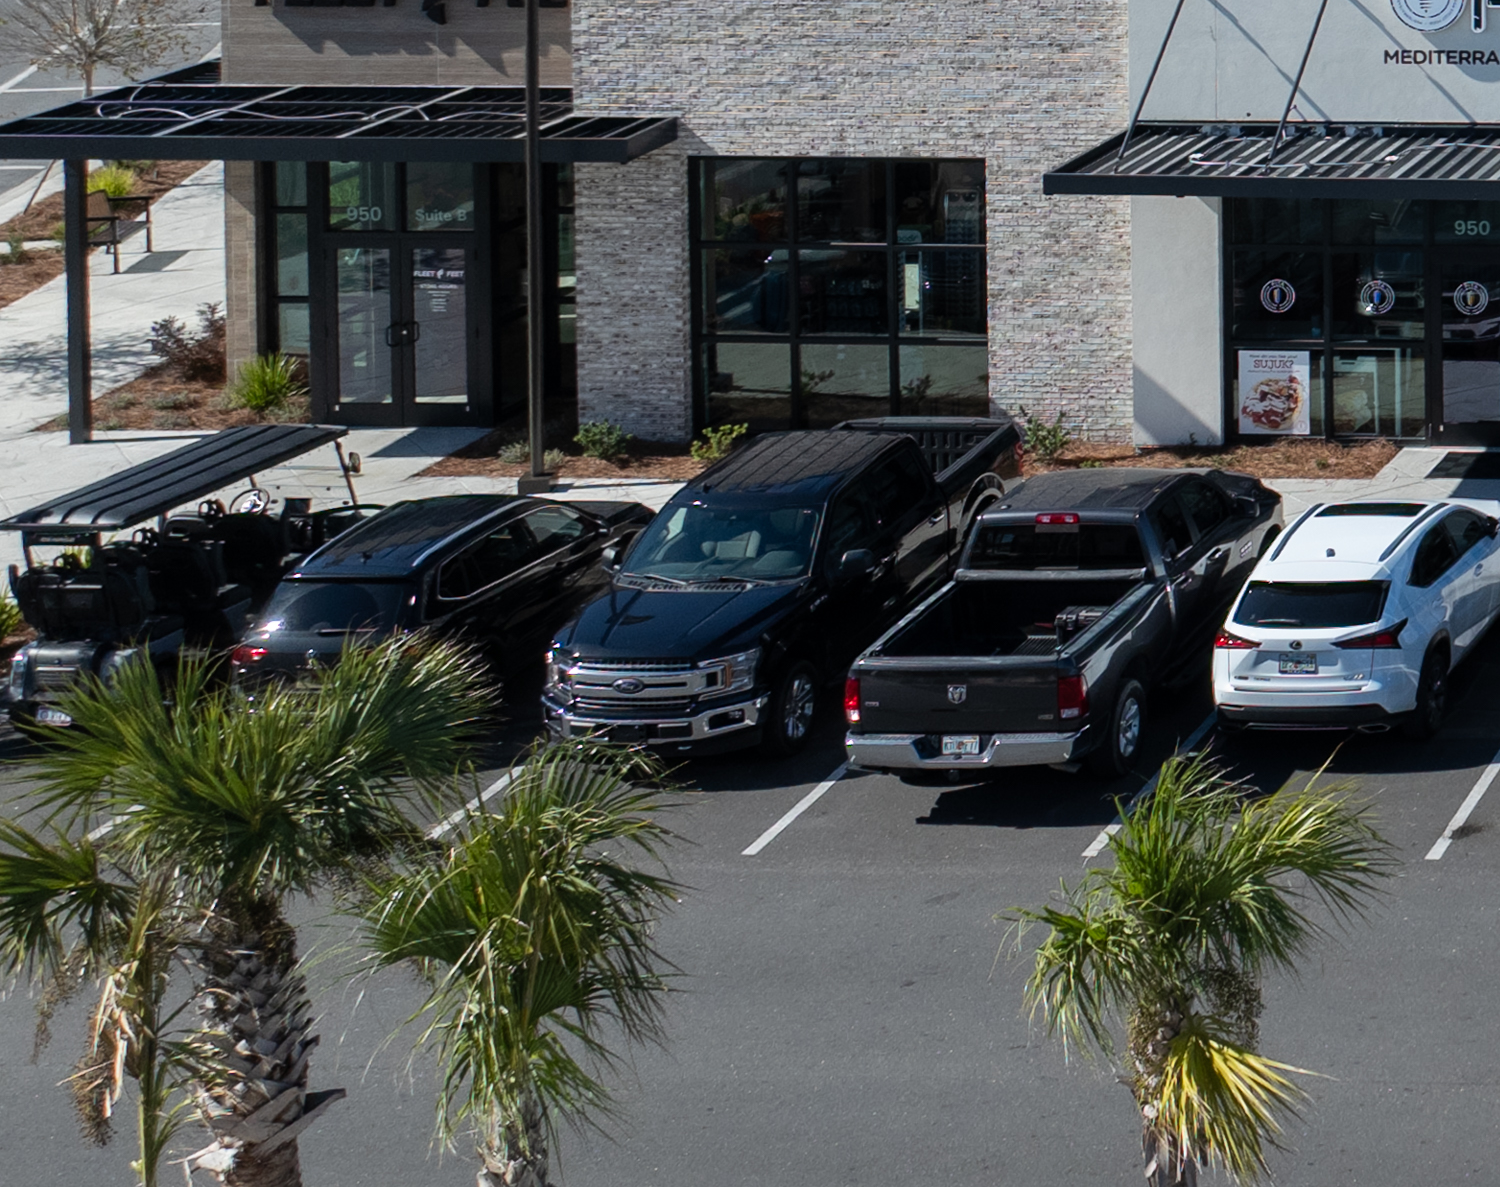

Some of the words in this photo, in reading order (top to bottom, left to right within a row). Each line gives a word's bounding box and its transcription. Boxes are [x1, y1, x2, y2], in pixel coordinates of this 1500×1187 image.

[346, 206, 382, 222] 950
[415, 209, 453, 222] Suite
[457, 209, 467, 222] B
[1454, 220, 1491, 236] 950
[1253, 360, 1294, 370] SUJUK?
